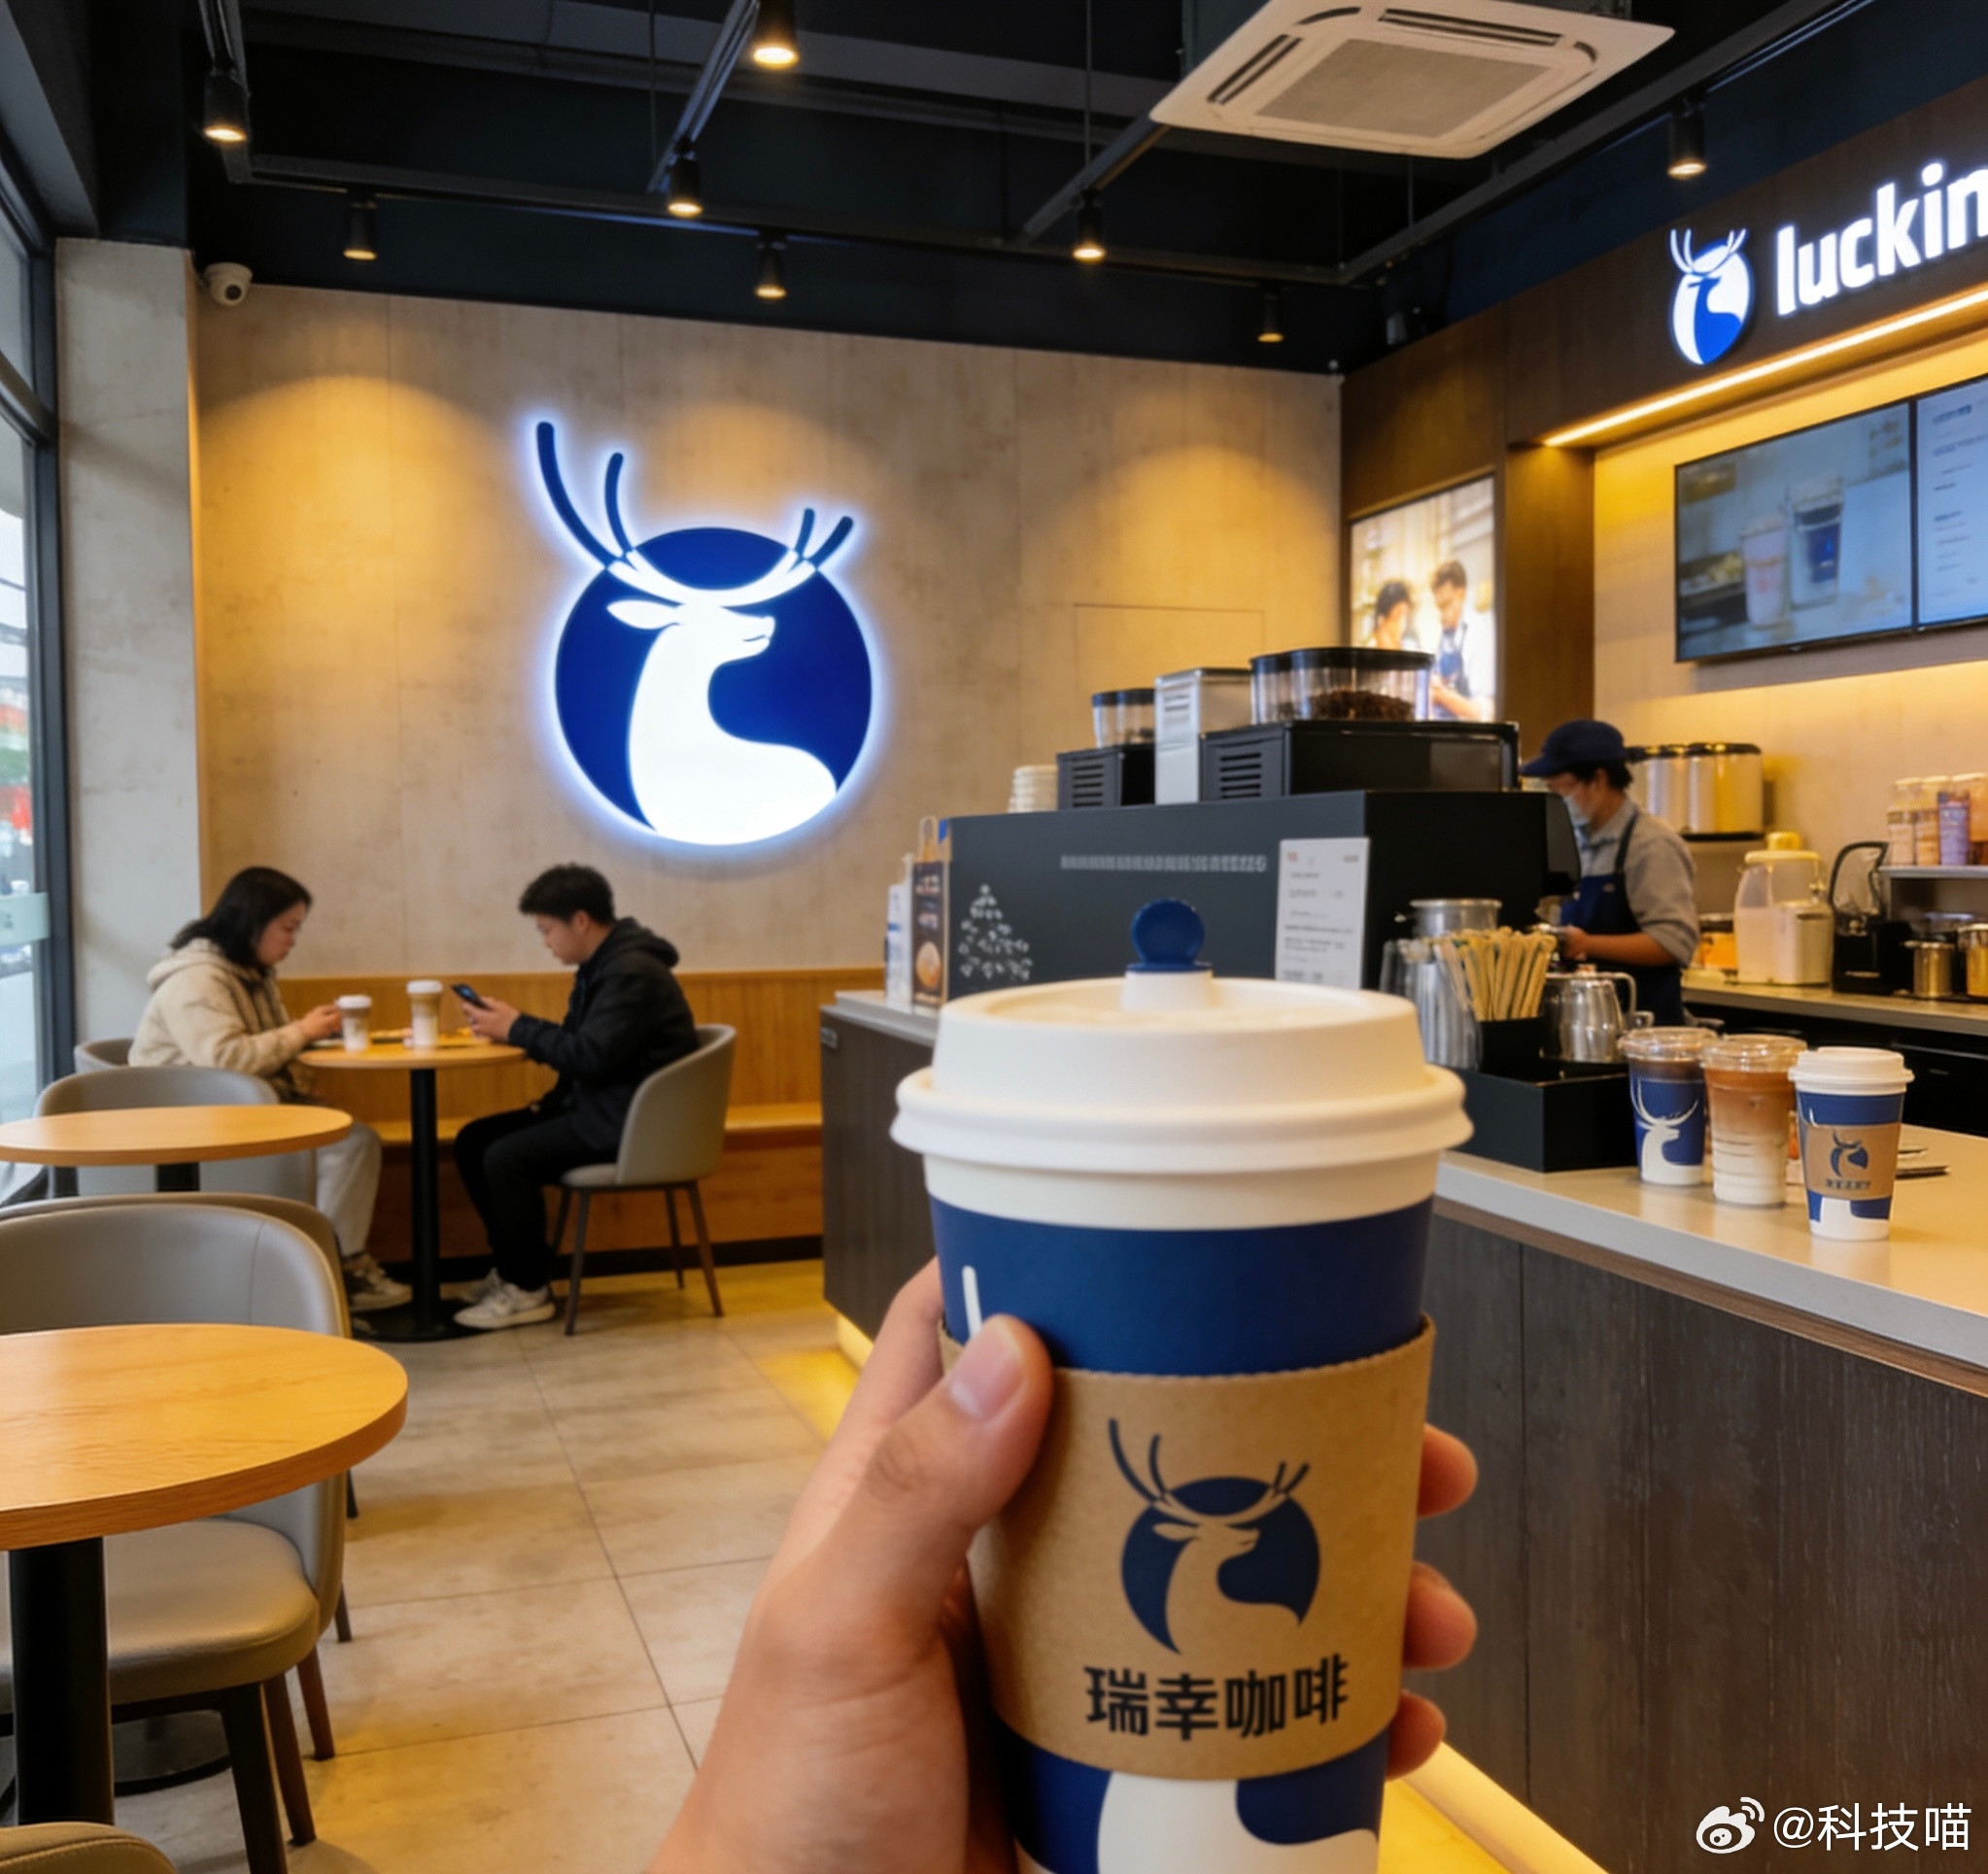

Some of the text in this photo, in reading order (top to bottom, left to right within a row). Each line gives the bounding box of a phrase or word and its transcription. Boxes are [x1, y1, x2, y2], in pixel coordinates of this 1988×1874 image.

[1776, 161, 1988, 317] luckin
[1083, 1653, 1349, 1741] 瑞幸咖啡
